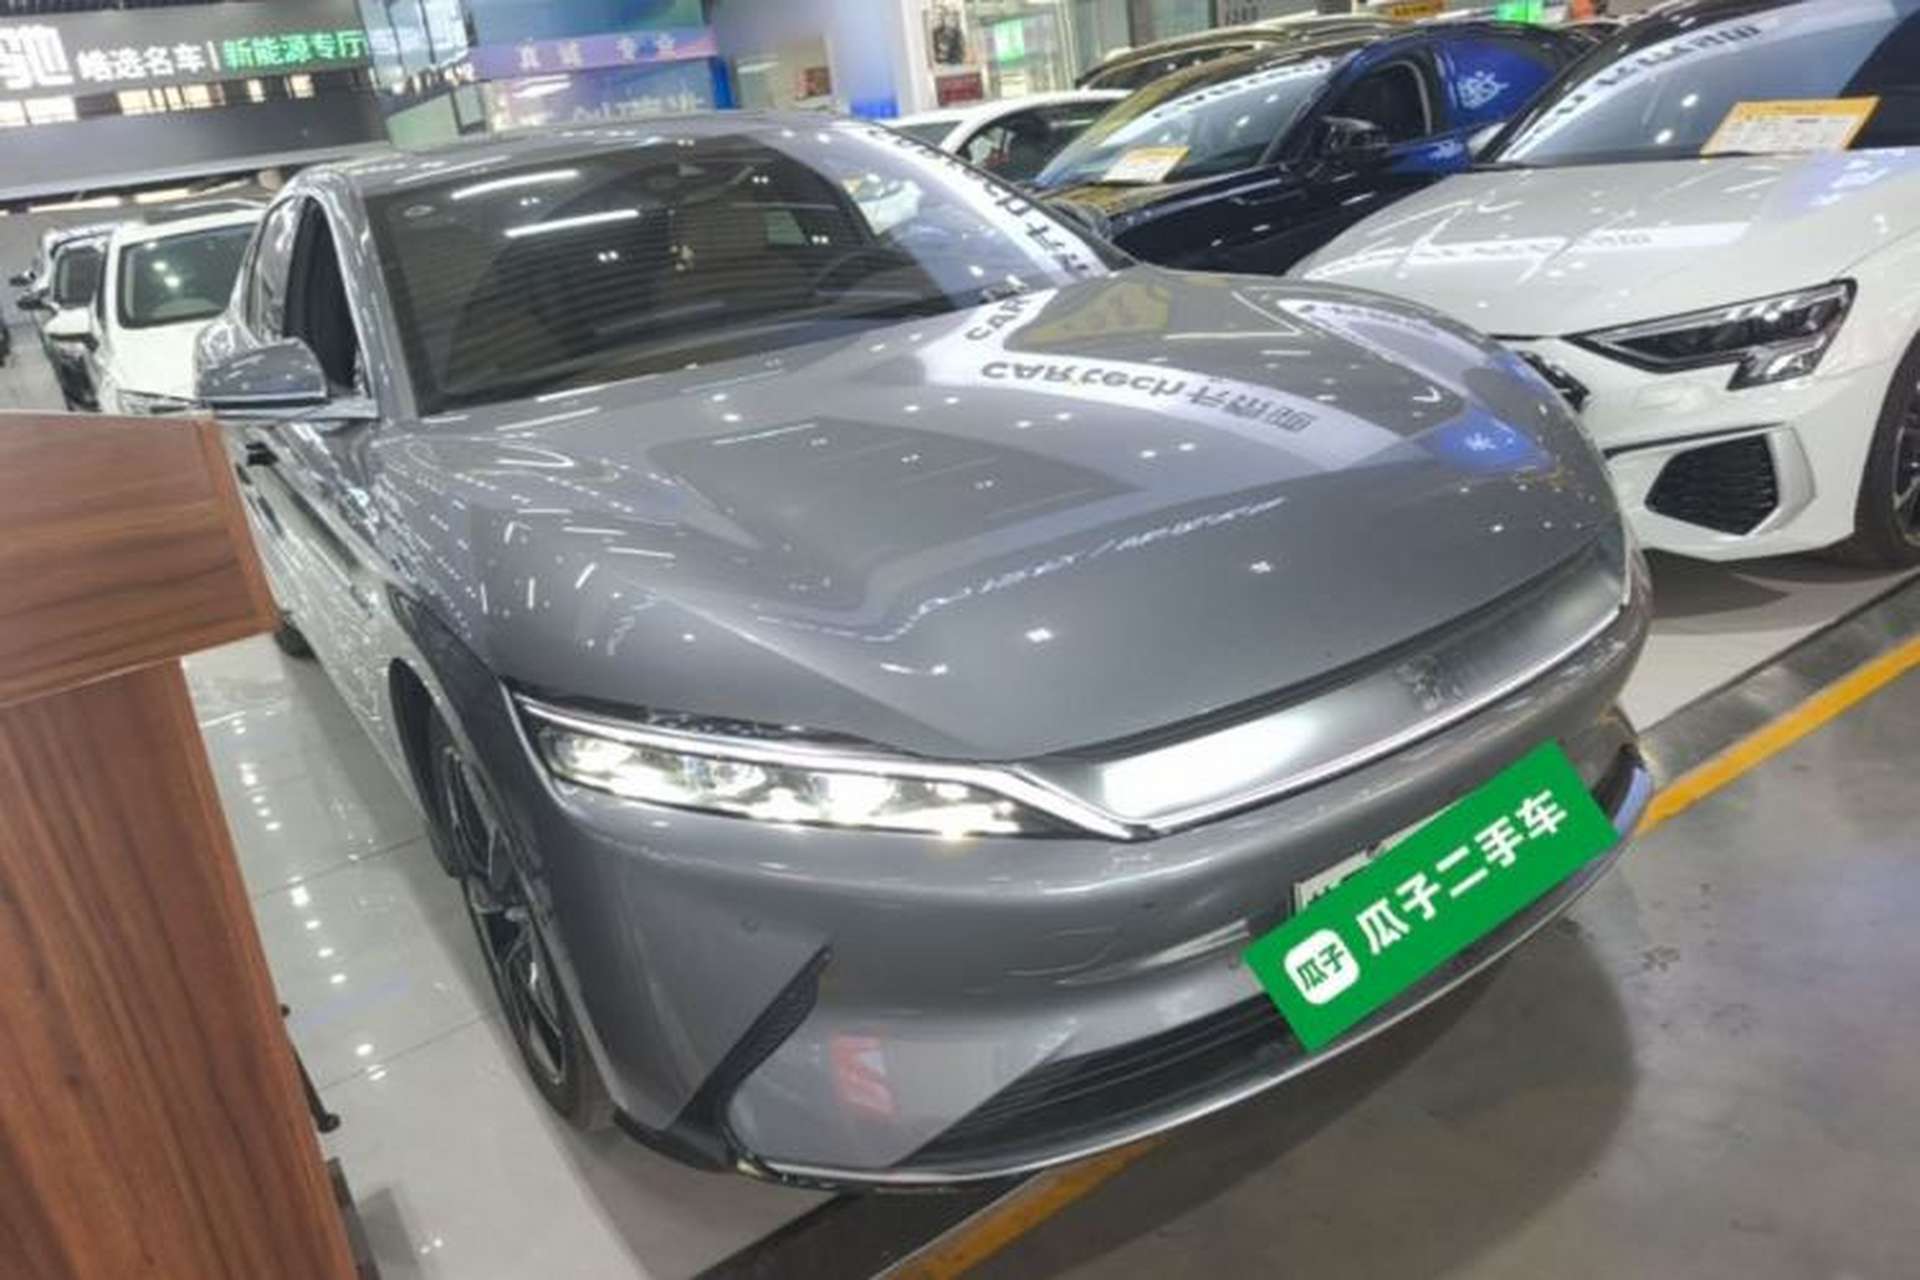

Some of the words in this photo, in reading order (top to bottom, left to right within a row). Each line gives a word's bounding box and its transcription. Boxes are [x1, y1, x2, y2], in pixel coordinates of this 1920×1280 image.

[222, 29, 369, 70] 新能源专厅
